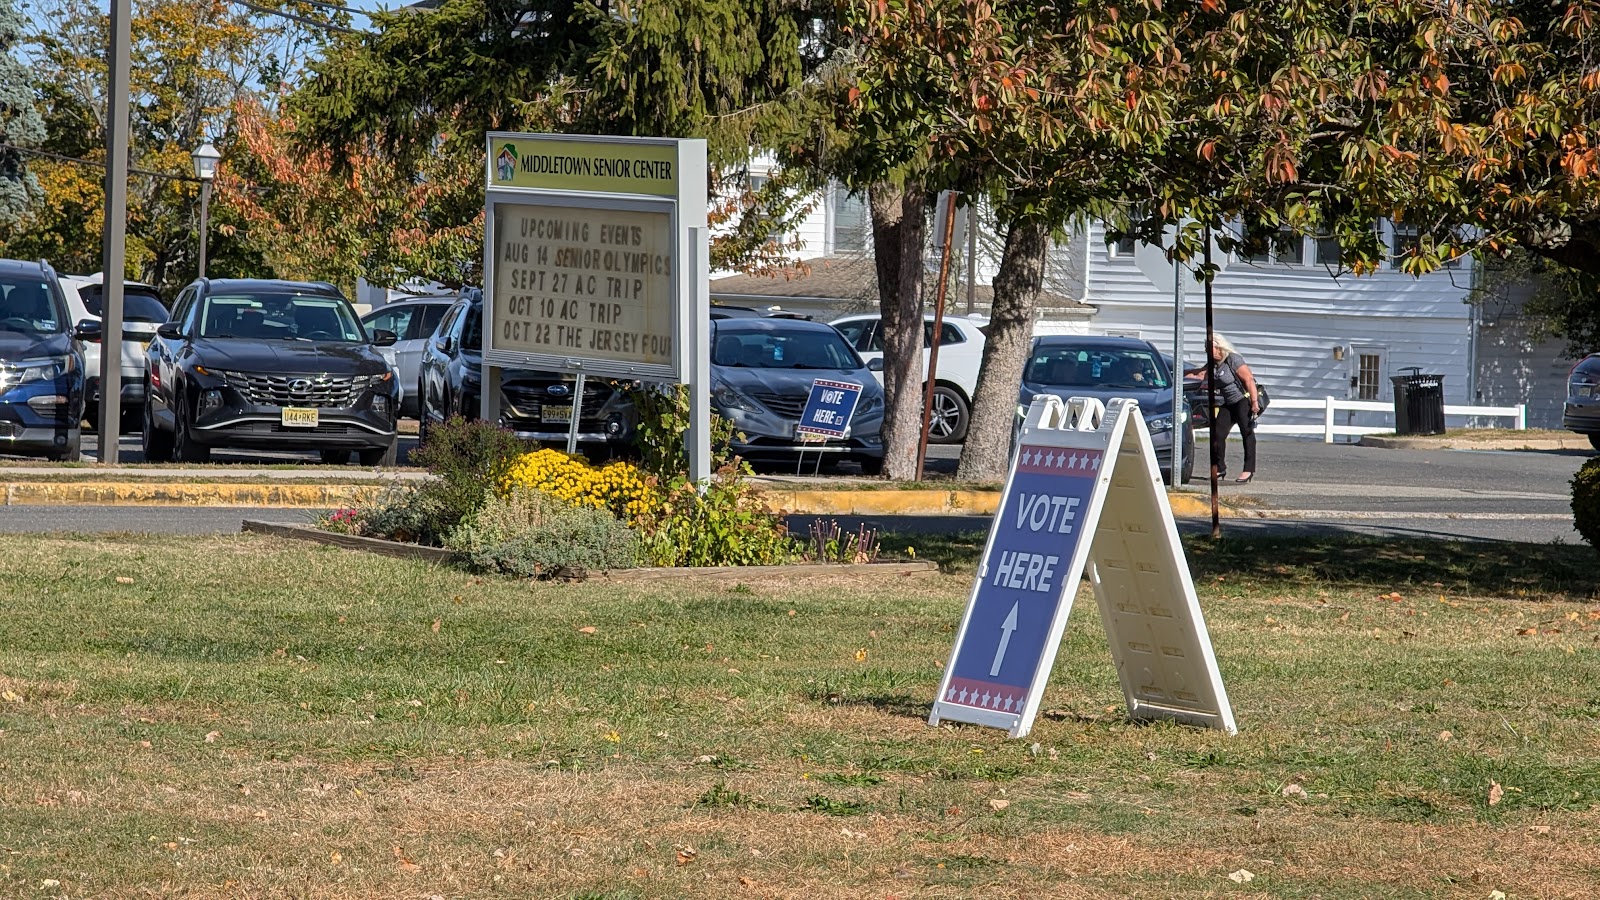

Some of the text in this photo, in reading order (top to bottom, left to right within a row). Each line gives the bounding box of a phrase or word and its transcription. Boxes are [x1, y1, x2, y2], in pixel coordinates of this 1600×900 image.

[520, 154, 672, 180] MIDDLETOWN SENIOR CENTER
[521, 217, 642, 246] UPCOMING EVENTS
[504, 242, 671, 277] AUG 14 SENIOR OLYMPICS
[511, 268, 642, 300] SEPT 27 AC TRIP
[509, 295, 622, 324] OCT 10 AC TRIP
[503, 320, 531, 342] OCT
[535, 323, 550, 344] 22
[557, 325, 582, 348] THE
[589, 328, 638, 353] JERSEY
[820, 389, 845, 405] VOTE
[812, 408, 837, 424] HERE
[1016, 492, 1081, 534] VOTE
[993, 550, 1059, 593] HERE
